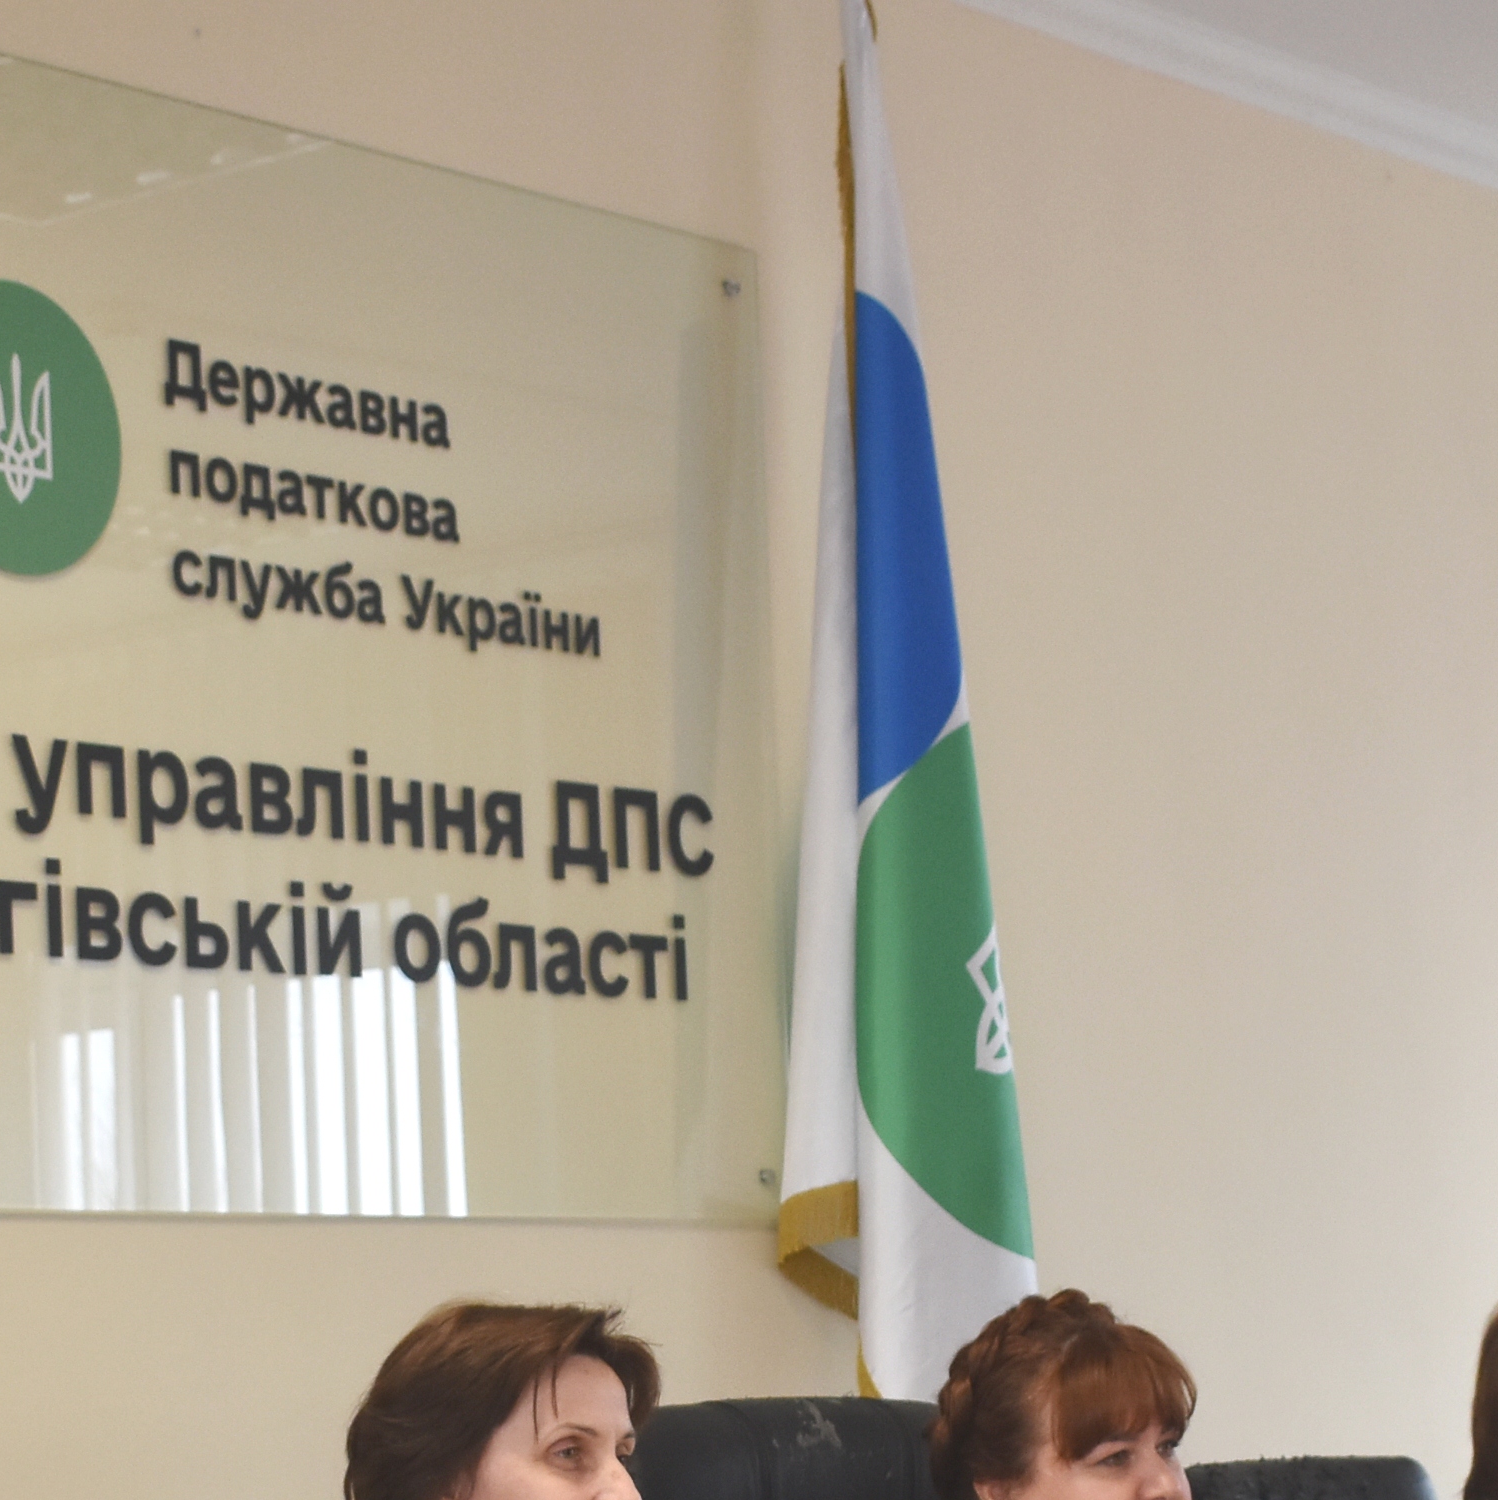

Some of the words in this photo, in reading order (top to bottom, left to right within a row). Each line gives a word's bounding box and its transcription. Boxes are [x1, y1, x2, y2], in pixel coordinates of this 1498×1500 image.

[163, 337, 452, 450] Державна
[167, 448, 461, 545] податкова
[171, 548, 387, 626] служба
[399, 573, 602, 659] України
[10, 732, 525, 860] управління
[549, 779, 715, 886] ДПС
[392, 896, 689, 1003] області
